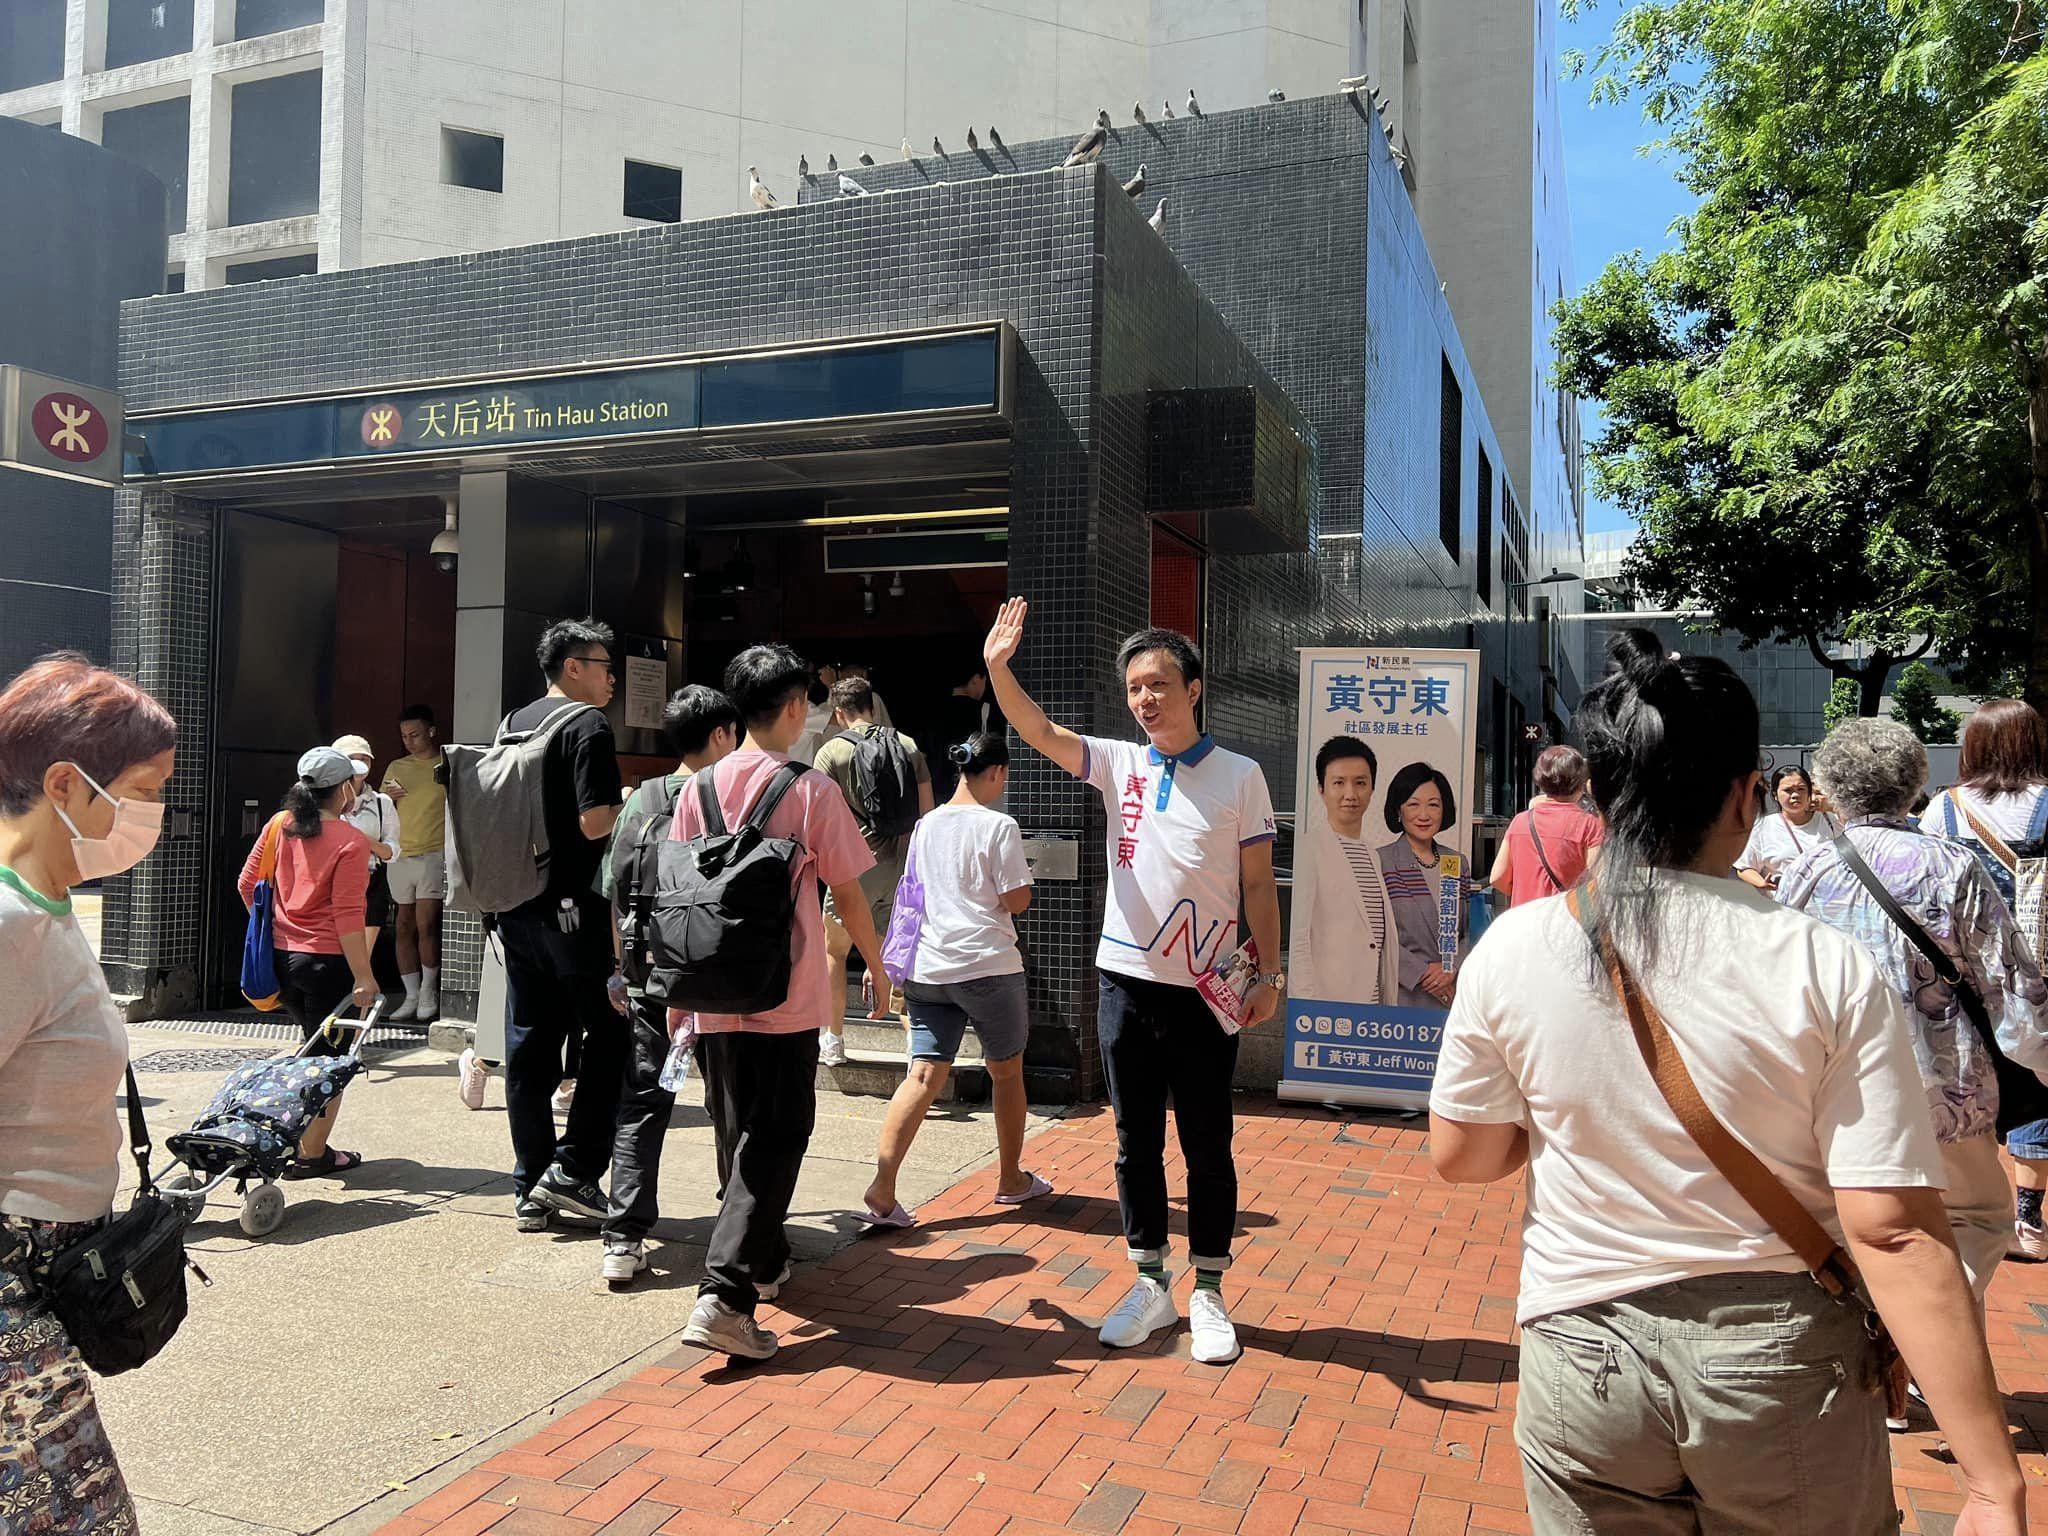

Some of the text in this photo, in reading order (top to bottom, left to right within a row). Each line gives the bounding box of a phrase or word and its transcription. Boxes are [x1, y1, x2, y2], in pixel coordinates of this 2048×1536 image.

[417, 395, 517, 439] 天后站
[523, 398, 669, 429] Tin Hau Station
[1326, 674, 1450, 716] 黃守東
[1344, 720, 1429, 736] 社區發展主任
[1116, 773, 1147, 869] 黃守東
[1356, 1020, 1442, 1043] 6360187
[1328, 1049, 1371, 1067] 黃守東
[1374, 1054, 1436, 1071] Jeff Won
